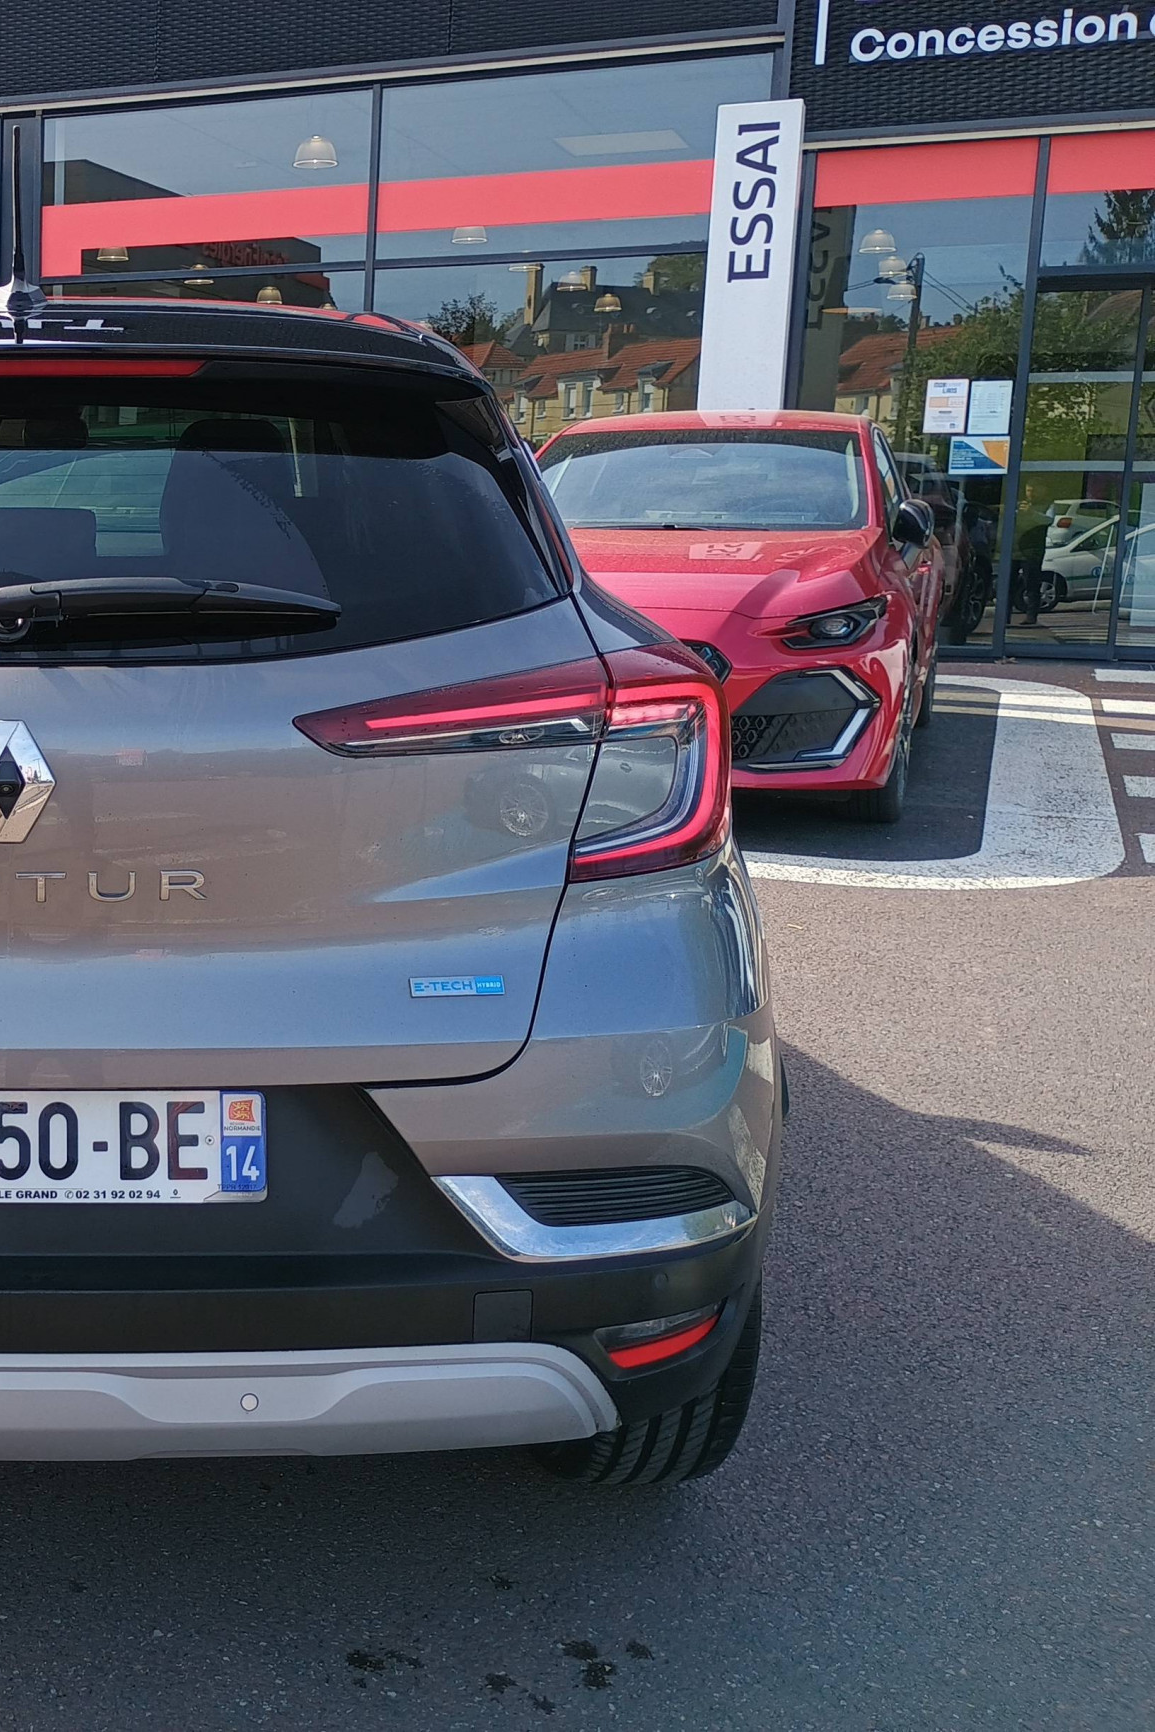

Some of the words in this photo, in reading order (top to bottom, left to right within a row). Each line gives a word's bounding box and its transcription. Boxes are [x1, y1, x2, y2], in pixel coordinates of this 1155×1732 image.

[850, 8, 1139, 62] Concession
[727, 121, 781, 283] ESSAI
[413, 980, 473, 992] E-TECH
[476, 981, 502, 989] HYBRID
[226, 1145, 260, 1182] 14
[15, 1189, 58, 1199] GRAND
[75, 1189, 90, 1199] 02
[93, 1189, 108, 1199] 31
[110, 1189, 126, 1199] 92
[128, 1189, 143, 1199] 02
[146, 1189, 161, 1199] 94
